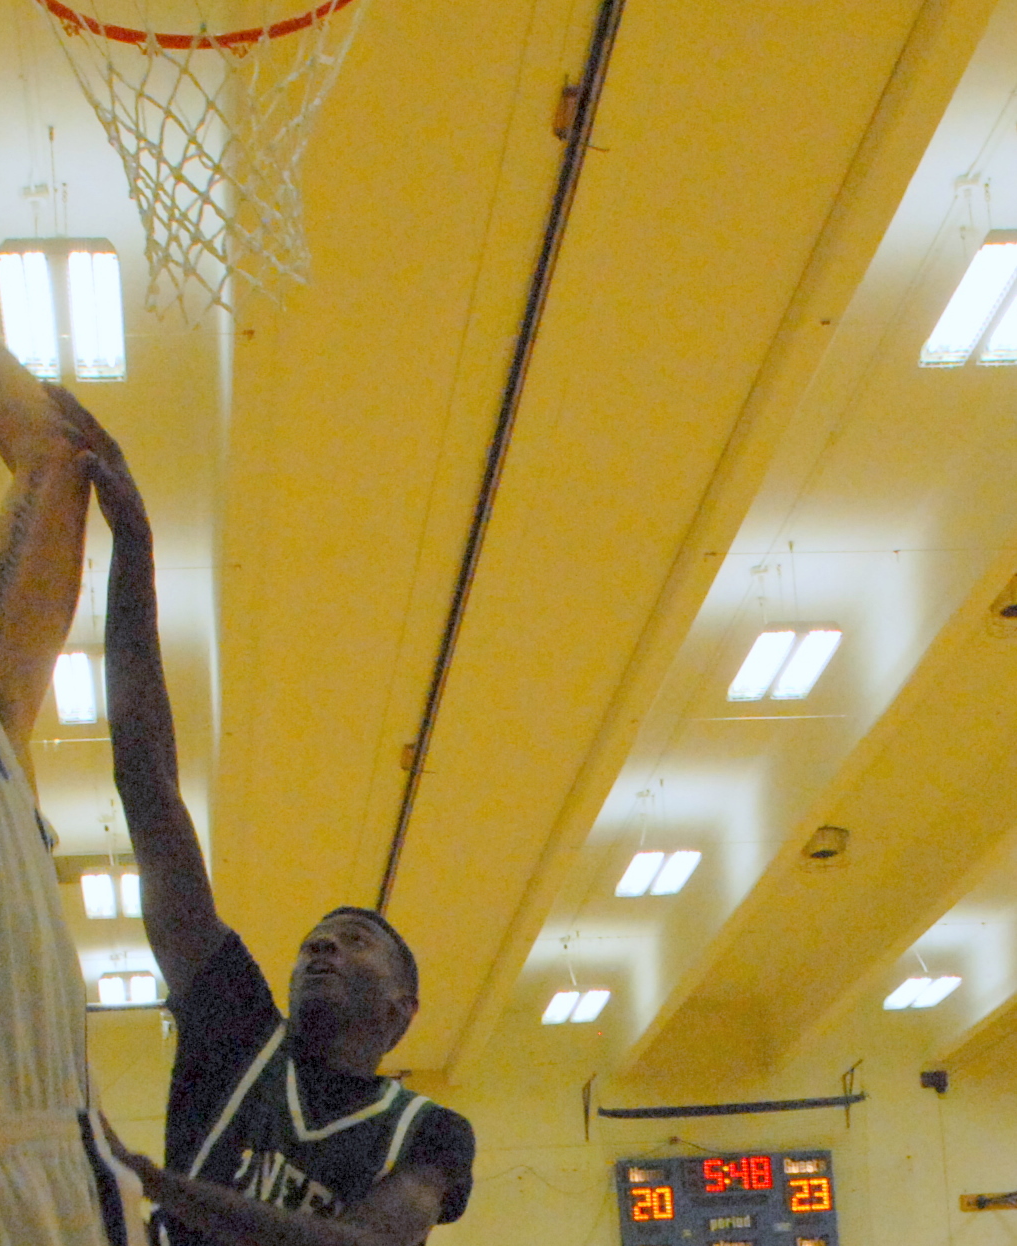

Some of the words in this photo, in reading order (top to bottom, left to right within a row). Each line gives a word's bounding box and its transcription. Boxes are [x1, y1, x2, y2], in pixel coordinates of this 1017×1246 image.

[703, 1156, 773, 1192] 5:48
[630, 1185, 674, 1221] 20
[789, 1176, 832, 1213] 23
